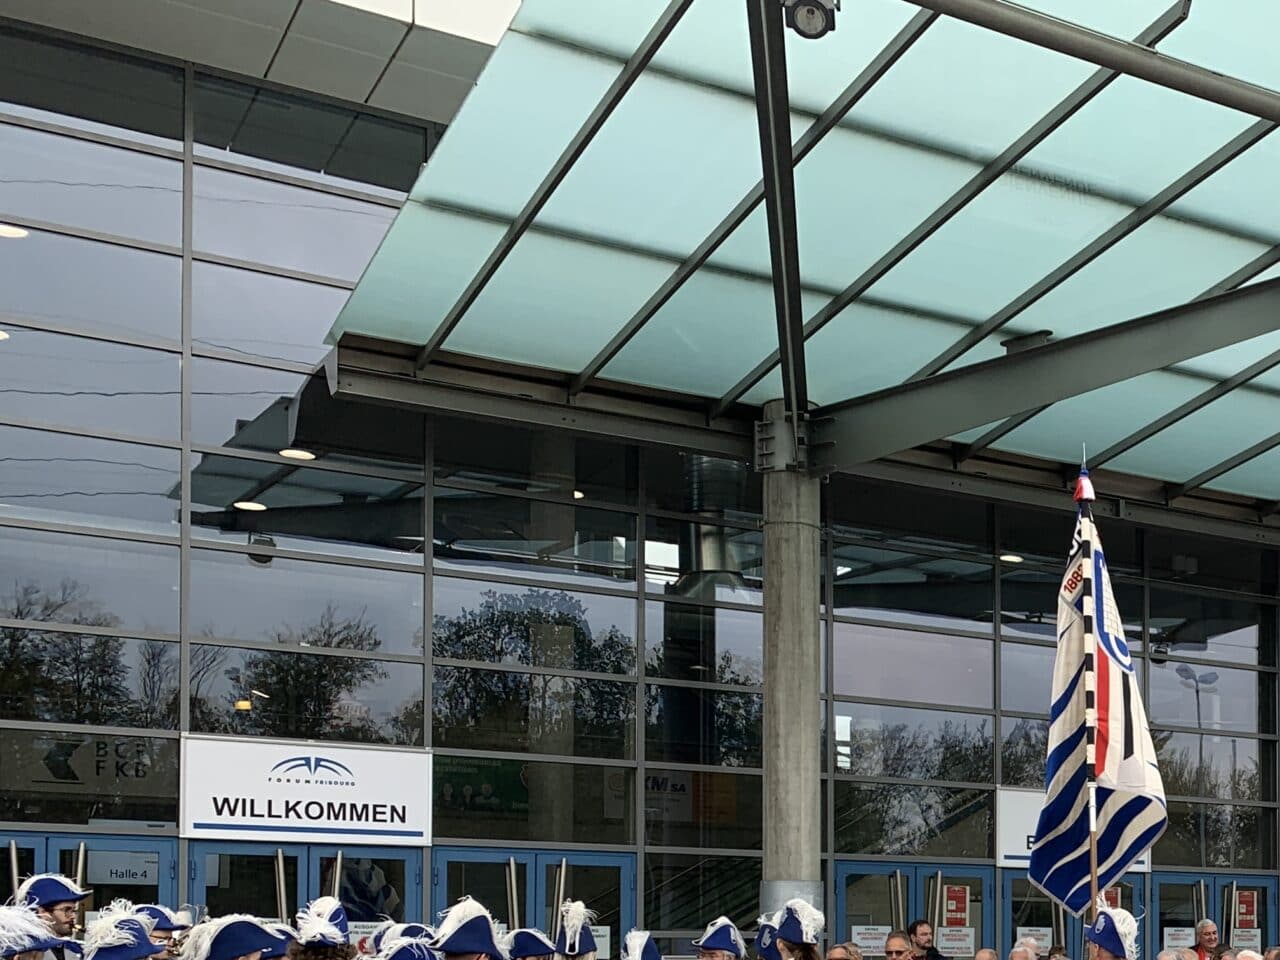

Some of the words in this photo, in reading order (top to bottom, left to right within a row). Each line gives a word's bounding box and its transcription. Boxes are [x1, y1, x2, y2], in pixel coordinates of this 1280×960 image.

[212, 796, 407, 824] WILLKOMMEN
[109, 868, 138, 879] Halle
[140, 870, 147, 879] 4
